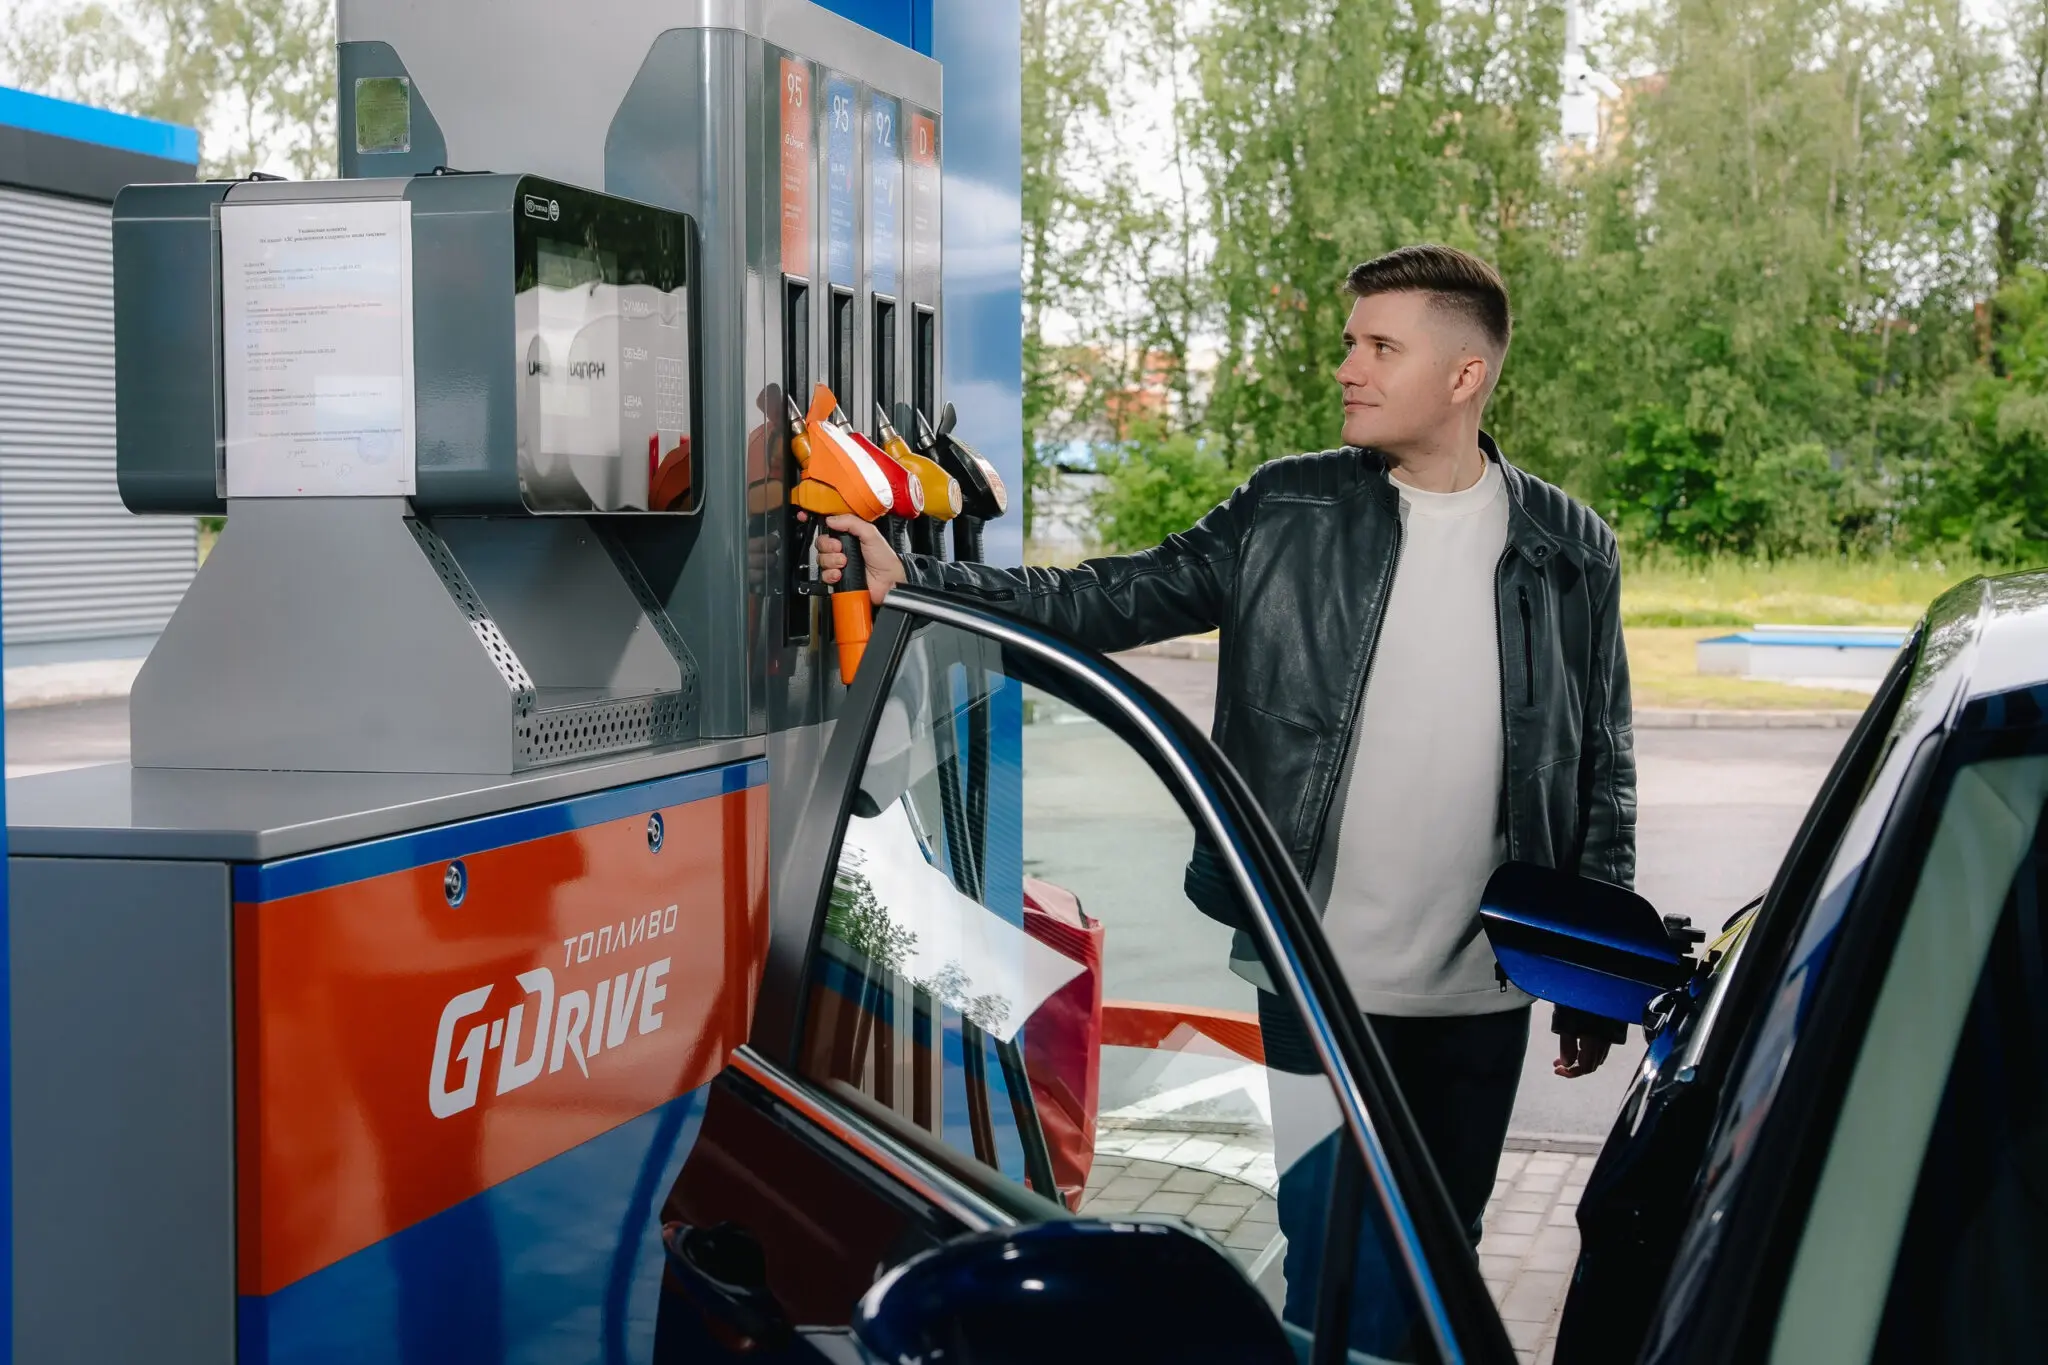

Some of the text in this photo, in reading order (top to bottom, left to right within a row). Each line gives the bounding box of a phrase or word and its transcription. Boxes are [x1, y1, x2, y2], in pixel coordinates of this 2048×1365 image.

[788, 73, 802, 108] 95
[833, 95, 849, 132] 95
[876, 112, 892, 148] 92
[919, 126, 927, 155] D
[563, 903, 679, 968] ТОПЛИВО
